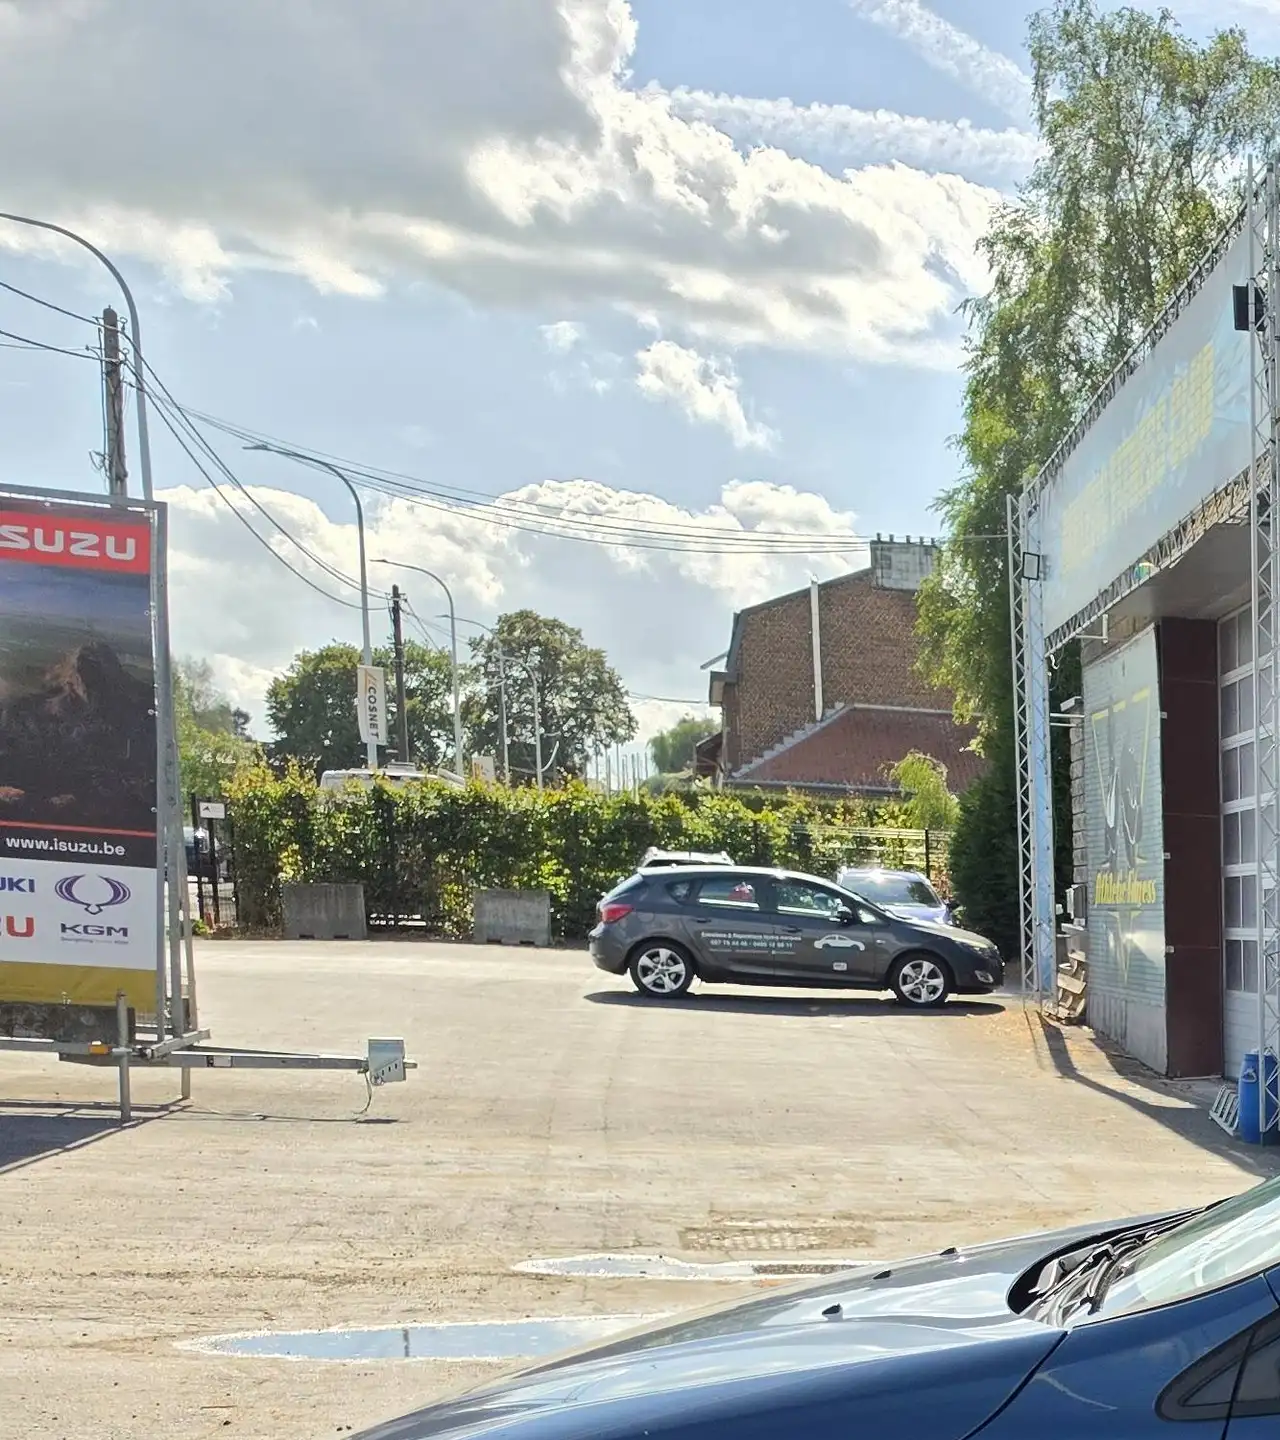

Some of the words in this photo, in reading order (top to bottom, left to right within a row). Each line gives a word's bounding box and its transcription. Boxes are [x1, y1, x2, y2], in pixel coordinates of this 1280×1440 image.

[367, 685, 380, 740] COSNET
[6, 837, 126, 856] www.isuzu.be
[60, 922, 129, 938] KGM
